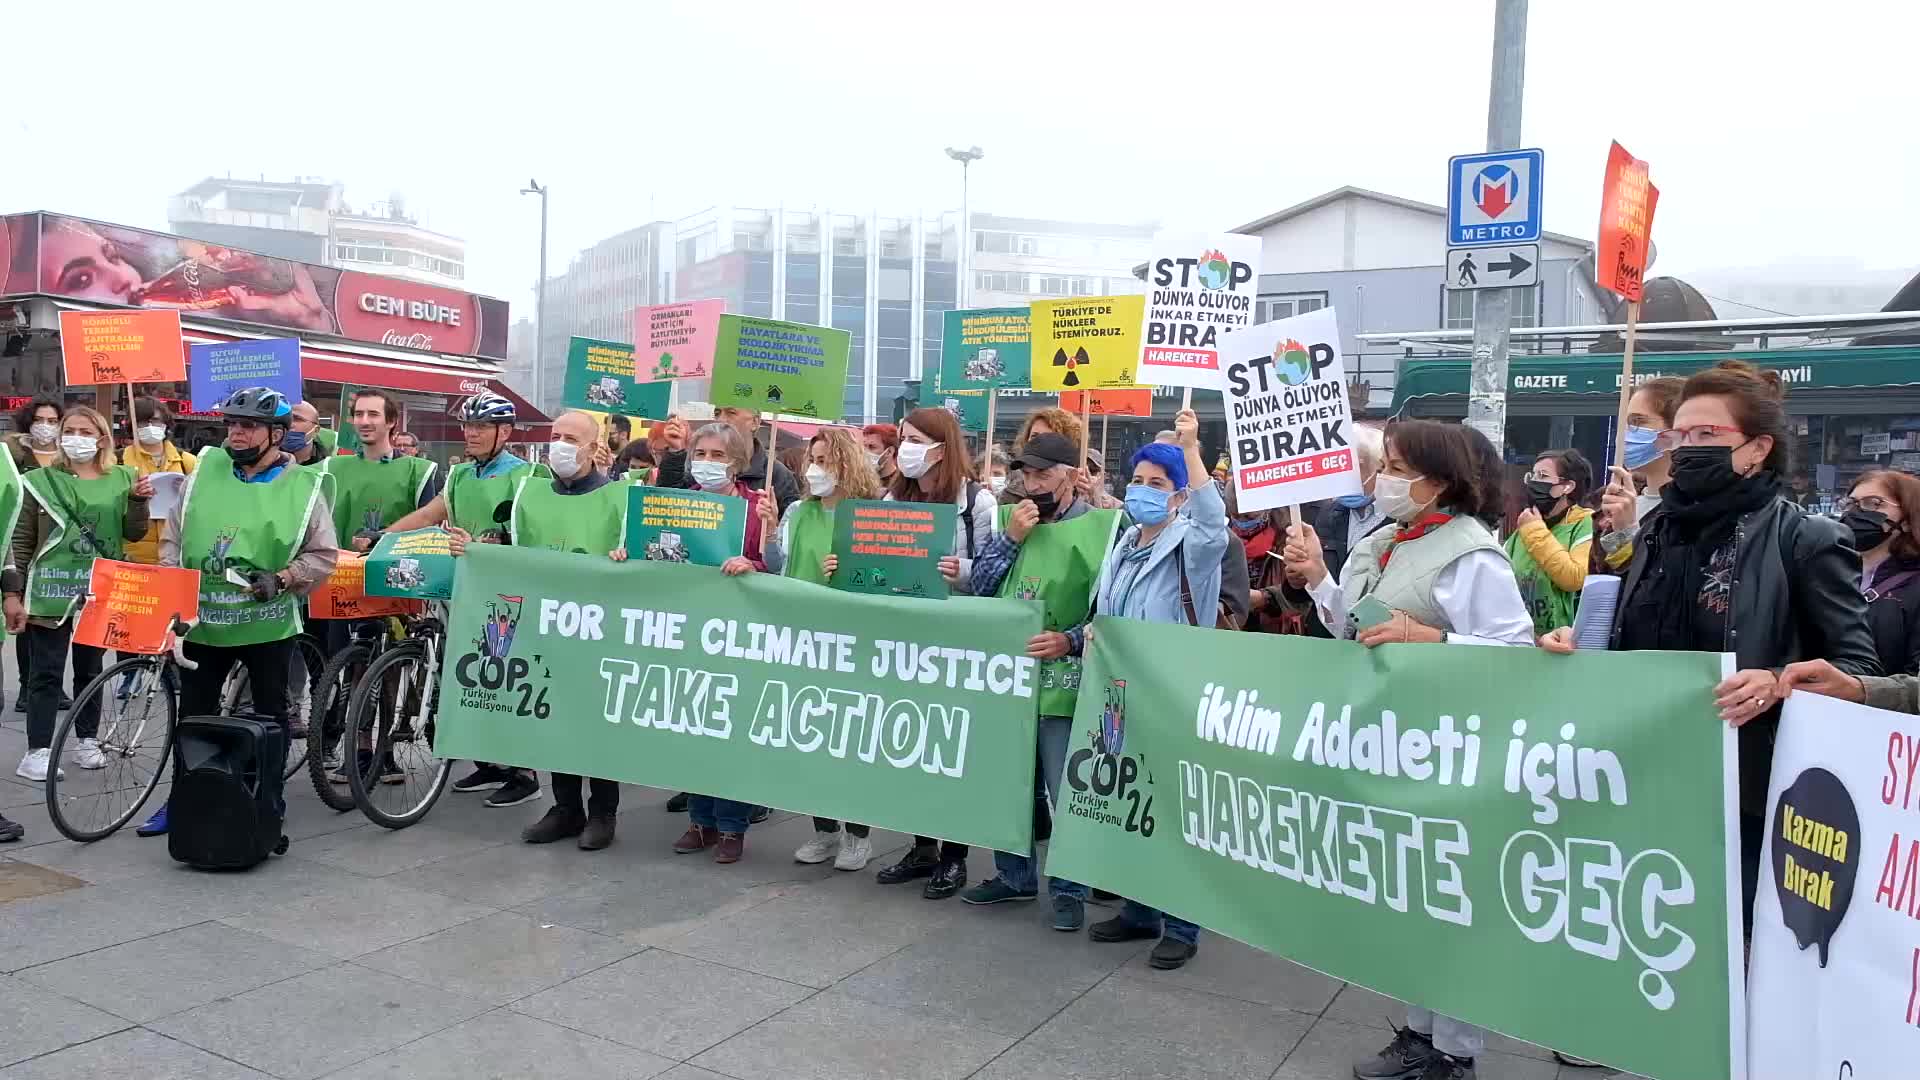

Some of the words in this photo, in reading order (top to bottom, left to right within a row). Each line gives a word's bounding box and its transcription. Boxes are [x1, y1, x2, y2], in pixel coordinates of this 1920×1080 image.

[1462, 225, 1526, 241] METRO
[358, 292, 404, 317] CEM
[409, 299, 461, 327] BÜFE
[651, 310, 692, 320] ORMANLARI
[1053, 306, 1112, 318] TÜRKİYE'DE
[1151, 307, 1192, 320] İNKAR
[1197, 311, 1248, 325] ETMEYİ
[1153, 287, 1194, 306] DÜNYA
[1198, 289, 1250, 311] ÖLÜYOR
[1053, 317, 1096, 328] NÜKLEER
[1053, 327, 1125, 339] İSTEMİYORUZ.
[1147, 322, 1231, 348] BIRA
[1149, 350, 1210, 364] HAREKETE
[1514, 375, 1567, 388] GAZETE
[1234, 395, 1281, 420] DÜNYA
[1284, 381, 1342, 409] ÖLÜYOR
[1236, 416, 1282, 436] İNKAR
[1287, 401, 1344, 426] ETMEYİ
[1237, 419, 1349, 466] BIRAK
[1246, 460, 1313, 484] HAREKETE
[1321, 454, 1348, 470] GEÇ
[539, 598, 605, 641] FOR
[620, 608, 687, 650] THE
[701, 618, 857, 673] CLIMATE
[871, 639, 1036, 698] JUSTICE
[455, 653, 529, 693] COP
[460, 699, 513, 713] Koalisyonu
[462, 688, 497, 702] Türkiye
[516, 683, 551, 720] 26
[600, 657, 739, 739] TAKE
[749, 679, 970, 778] ACTION
[1196, 682, 1281, 755] iklim
[1292, 702, 1481, 786] Adaleti
[1504, 719, 1628, 825] için
[1881, 731, 1920, 811] SY
[1067, 749, 1138, 800] COP
[1068, 803, 1122, 826] Koalisyonu
[1071, 791, 1109, 809] Türkiye
[1125, 789, 1155, 838] 26
[1782, 803, 1848, 864] Kazma
[1178, 760, 1473, 927] HAREKETE
[1500, 829, 1696, 1010] GEÇ
[1783, 852, 1834, 912] Bırak
